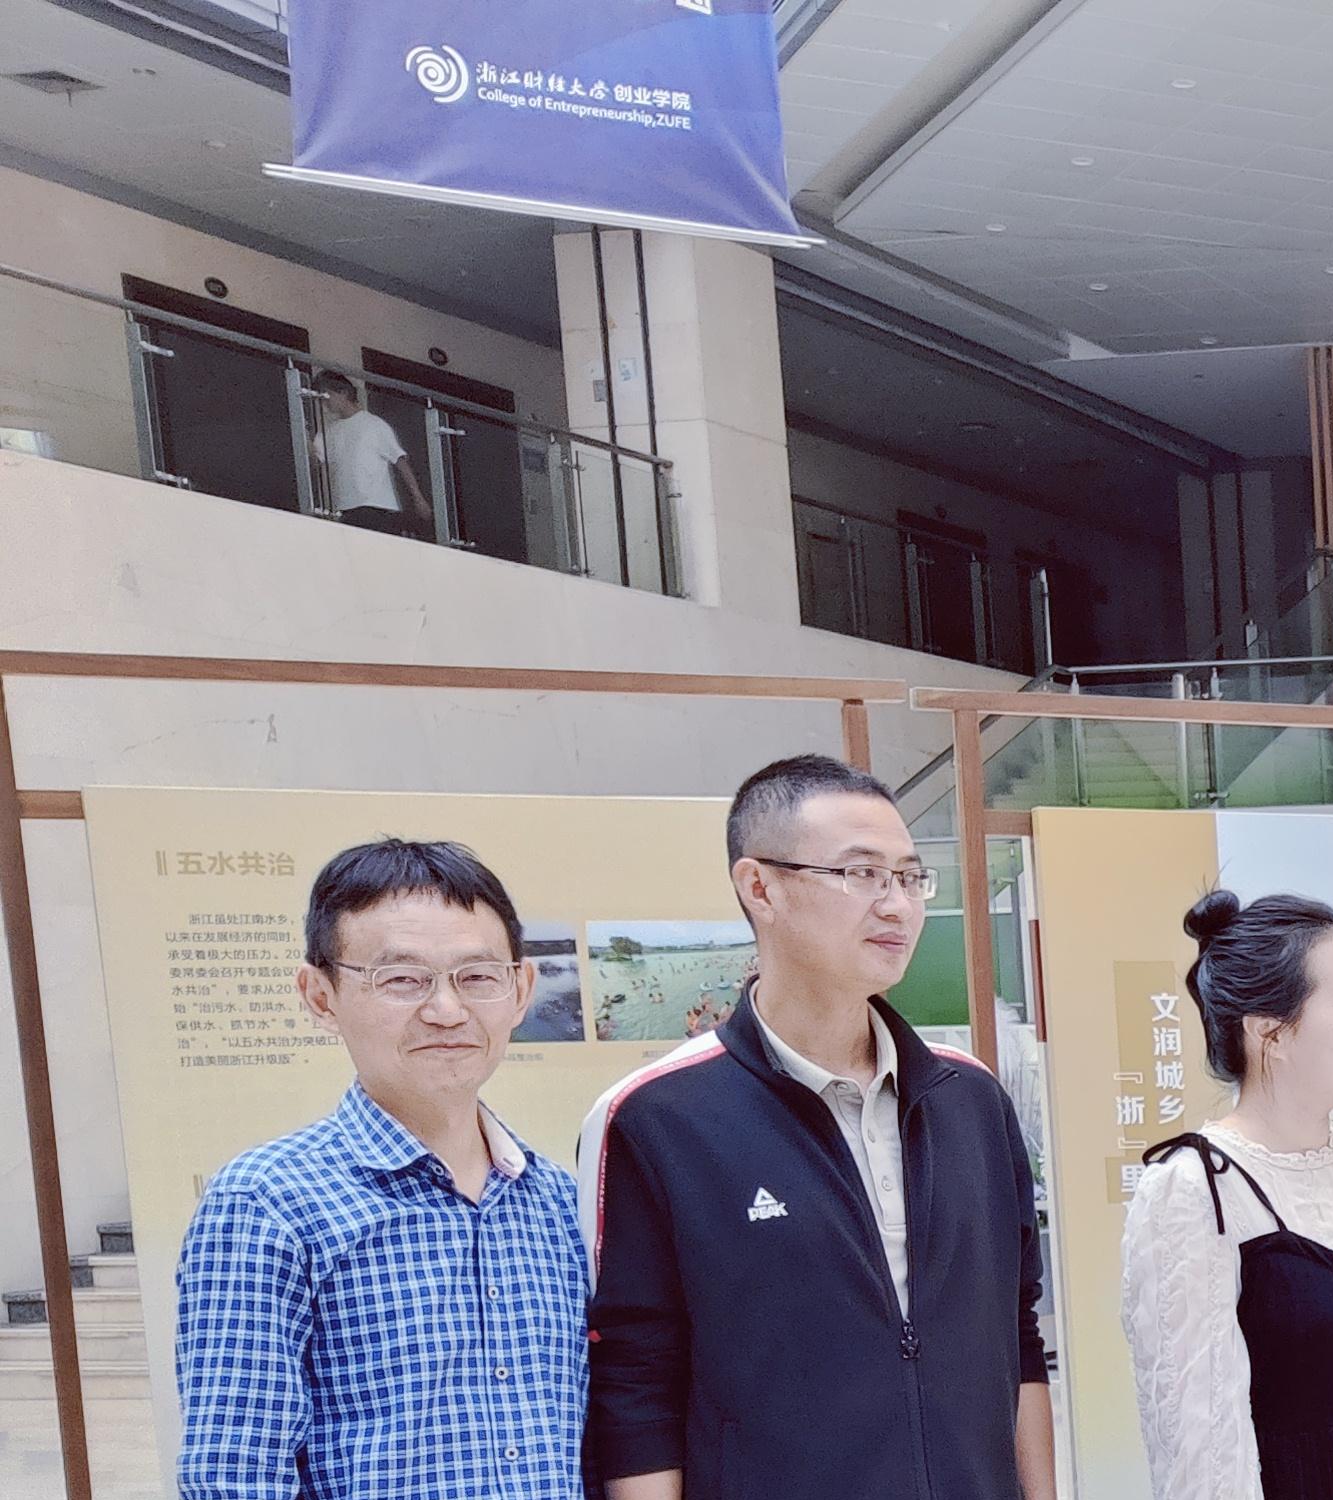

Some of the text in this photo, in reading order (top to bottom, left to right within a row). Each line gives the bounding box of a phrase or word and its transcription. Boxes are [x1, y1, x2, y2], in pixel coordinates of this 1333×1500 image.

[477, 87, 692, 130] College of Entrepreneurship,ZUFE
[613, 83, 692, 111] 创业学院
[177, 851, 296, 877] 五水共治
[168, 949, 303, 961] 承受着极大的压力。20
[169, 966, 298, 979] 委常委会召开专题会议
[174, 1002, 305, 1014] 始“治污水、防洪水、
[1150, 992, 1185, 1124] 文润城乡
[747, 1202, 789, 1222] PEAK
